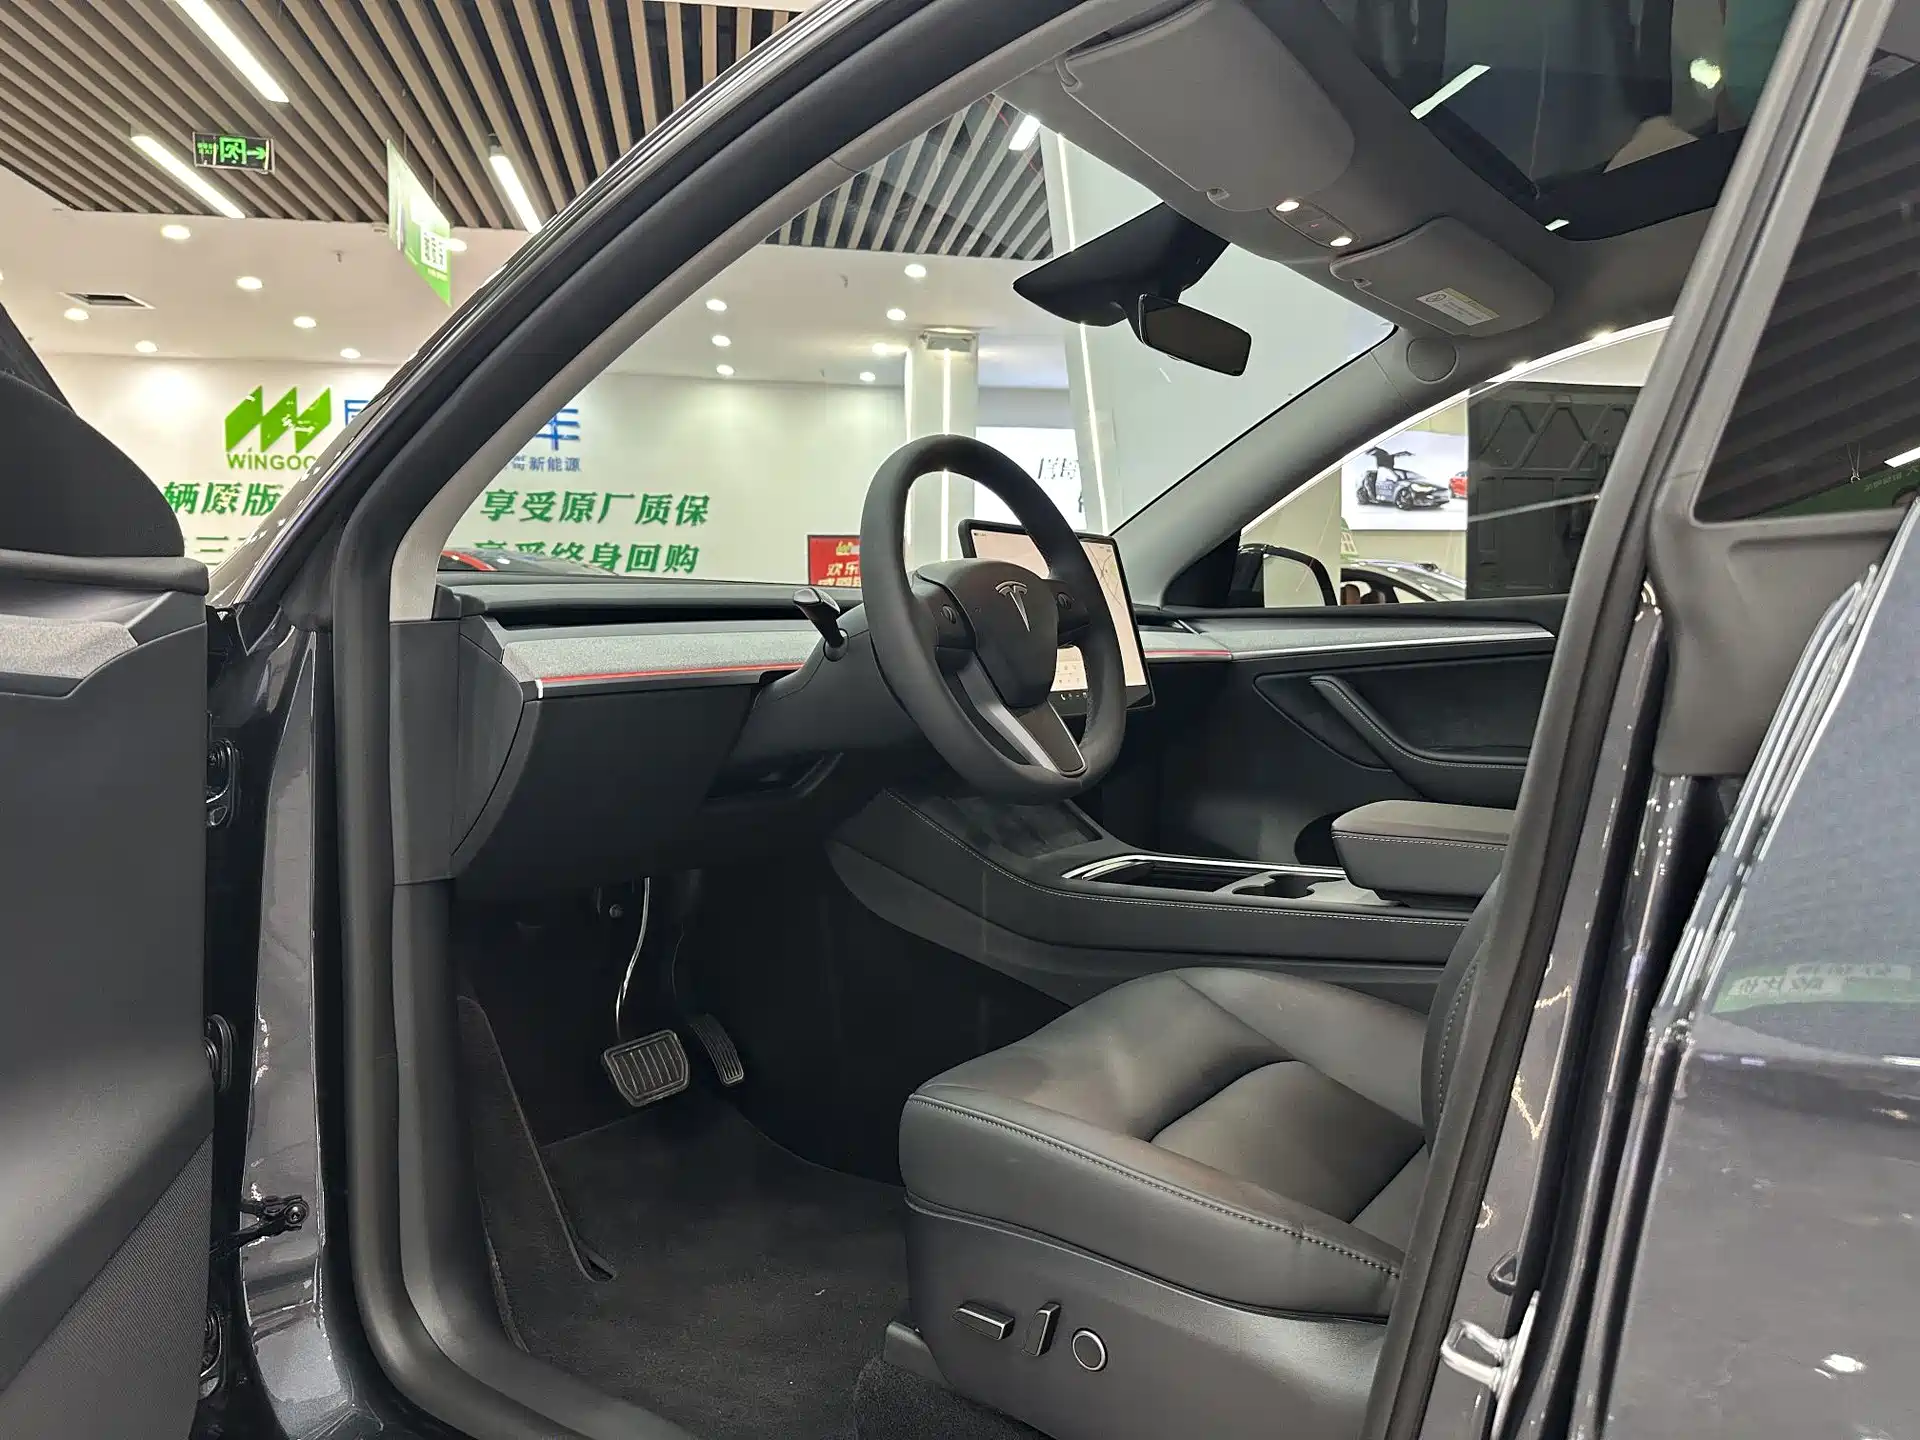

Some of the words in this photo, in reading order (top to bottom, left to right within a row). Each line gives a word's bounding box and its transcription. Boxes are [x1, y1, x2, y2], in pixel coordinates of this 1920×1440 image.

[481, 488, 710, 527] 享受原厂质保
